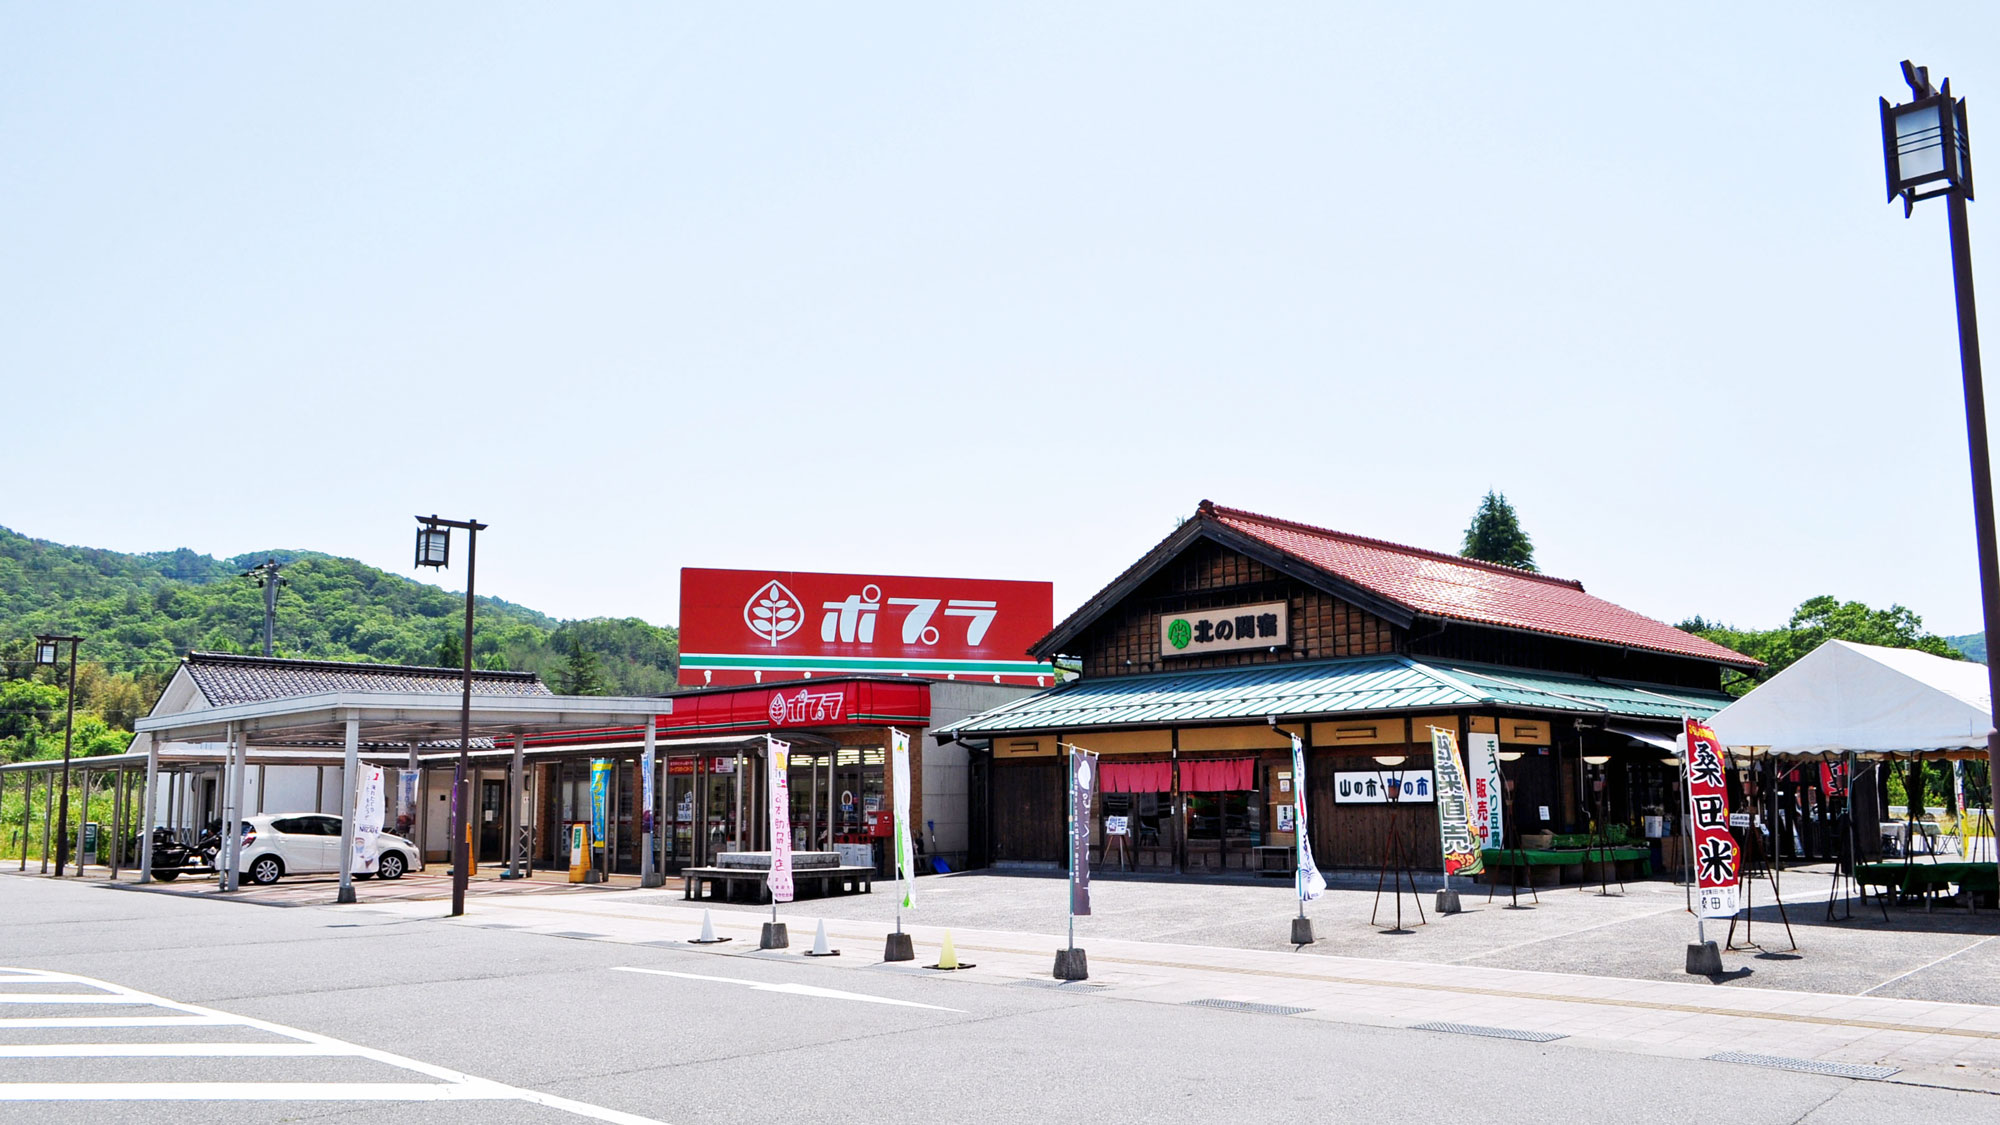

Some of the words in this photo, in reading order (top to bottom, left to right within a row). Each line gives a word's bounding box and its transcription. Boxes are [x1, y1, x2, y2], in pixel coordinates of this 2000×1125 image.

[821, 584, 998, 646] ポプラ
[1194, 613, 1277, 643] 北の関宿
[786, 689, 844, 723] ポプラ
[1437, 734, 1470, 853] 野菜直売
[1476, 778, 1488, 844] 販売中
[1691, 742, 1735, 884] 桑田米
